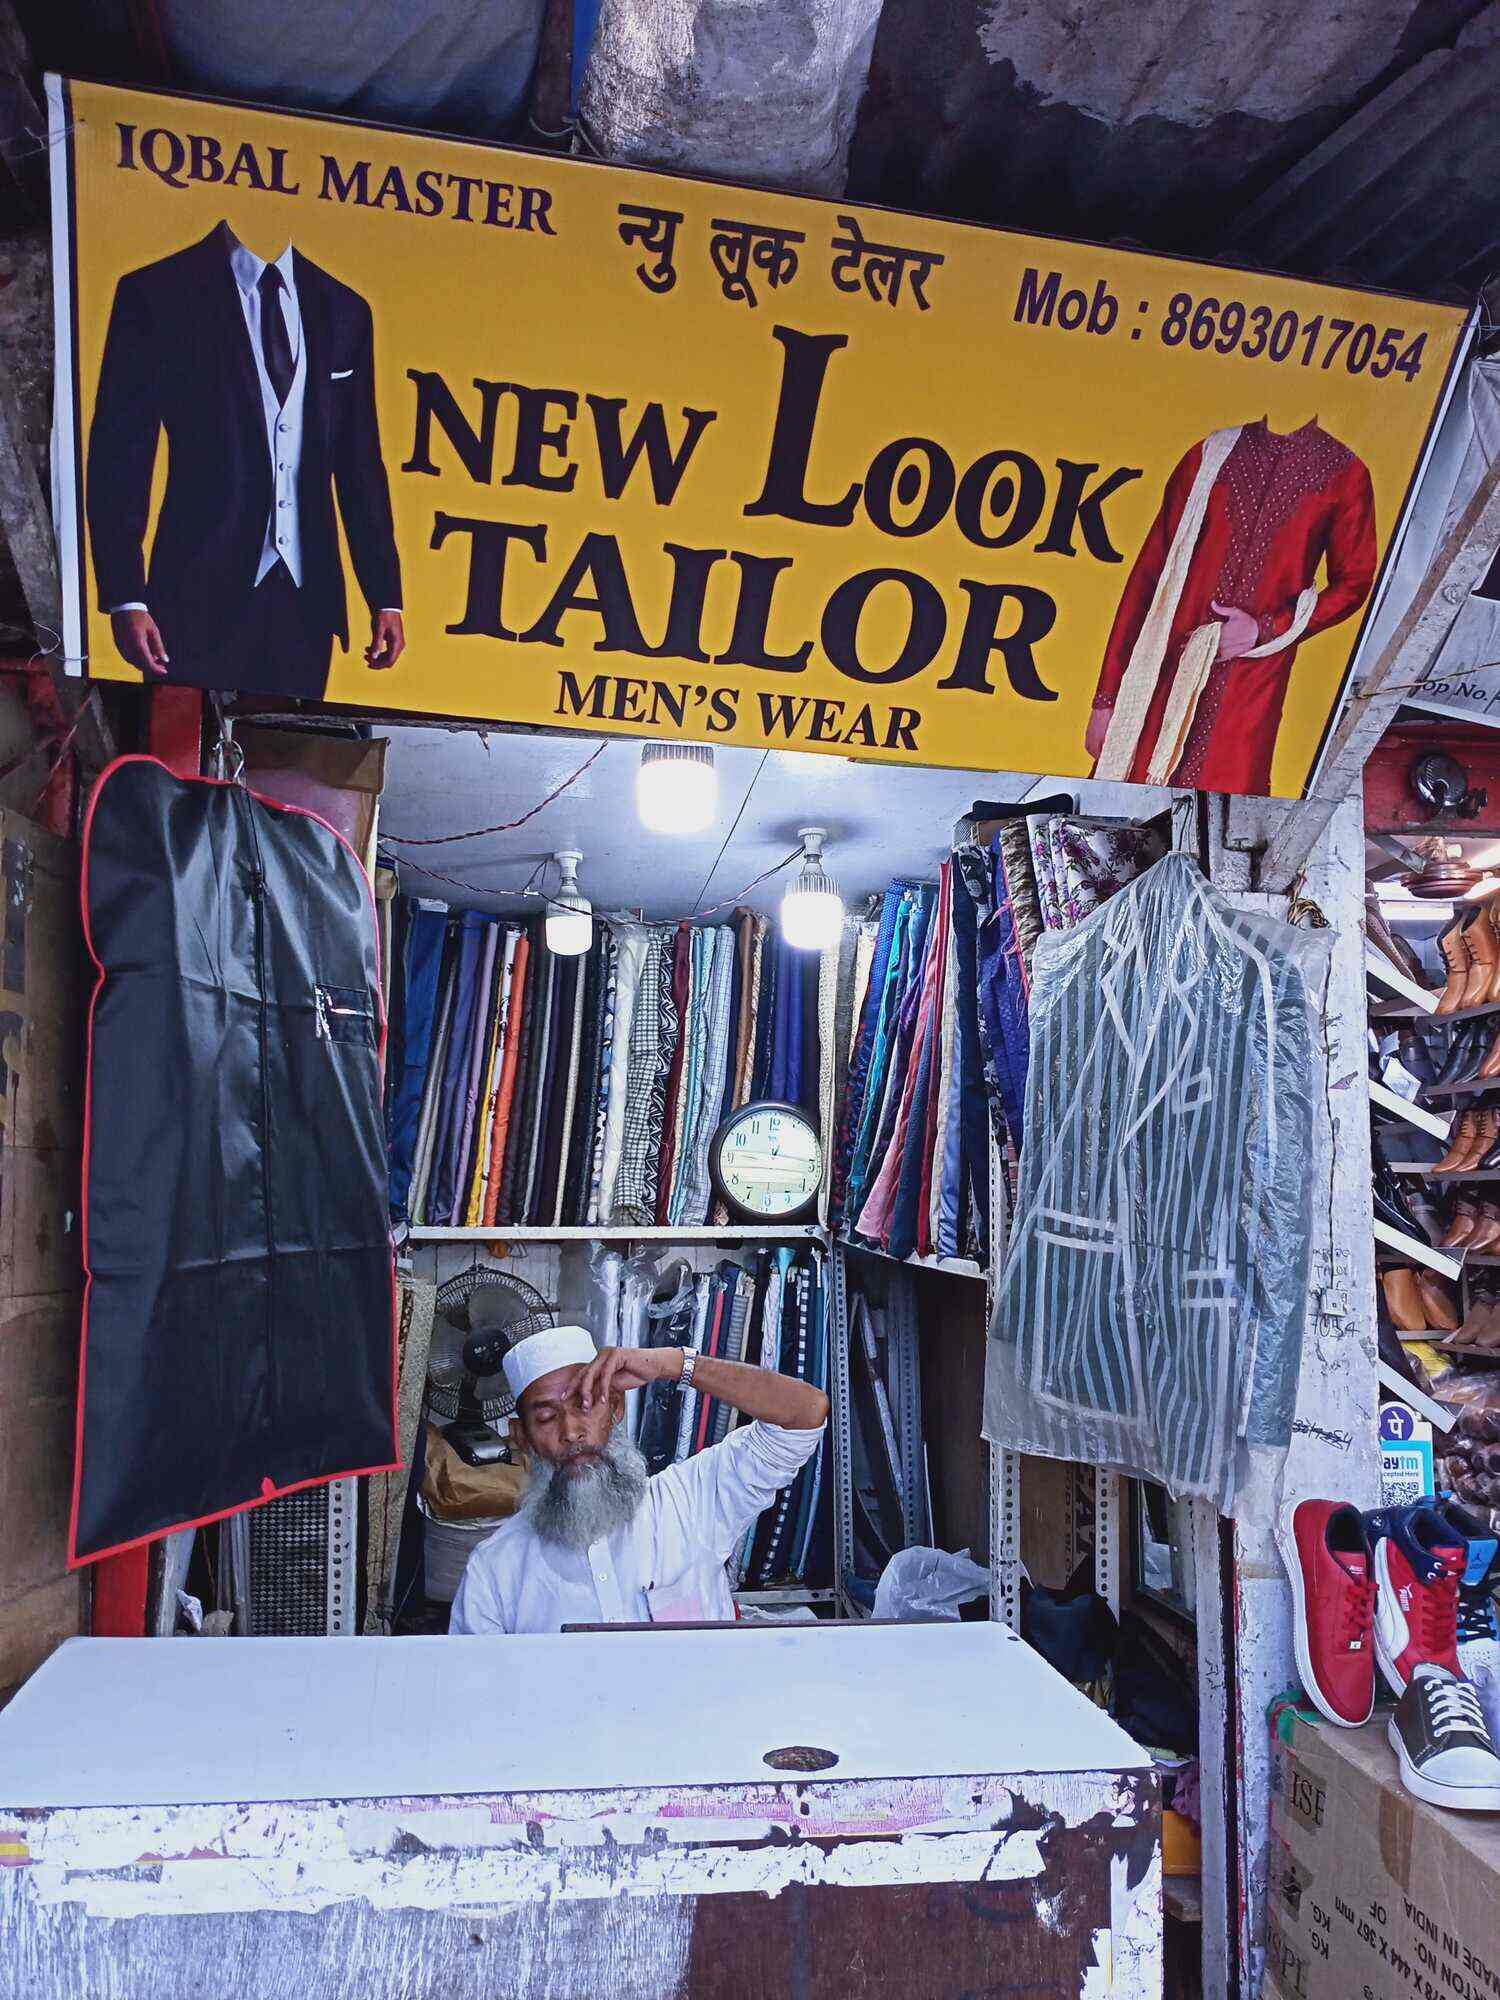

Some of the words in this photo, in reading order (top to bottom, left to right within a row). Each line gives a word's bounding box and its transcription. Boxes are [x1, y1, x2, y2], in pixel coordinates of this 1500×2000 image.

[115, 121, 299, 196] IQBAL
[318, 154, 558, 236] MASTER
[709, 218, 806, 309] लूक
[830, 214, 945, 311] टेलर
[1013, 267, 1119, 336] Mob
[1161, 292, 1428, 383] 8693017054
[401, 368, 718, 506] NEW
[742, 324, 1144, 564] LOOK
[429, 510, 1059, 702] TAILOR
[1453, 681, 1488, 701] No.
[757, 692, 922, 751] WEAR
[1383, 1456, 1418, 1470] aytm
[1311, 1901, 1331, 1933] KG.
[1335, 1896, 1355, 1924] mm
[1369, 1900, 1387, 1925] OF
[1403, 1897, 1439, 1944] INDIA
[1308, 1927, 1329, 1960] KG.
[1442, 1931, 1459, 1959] IN
